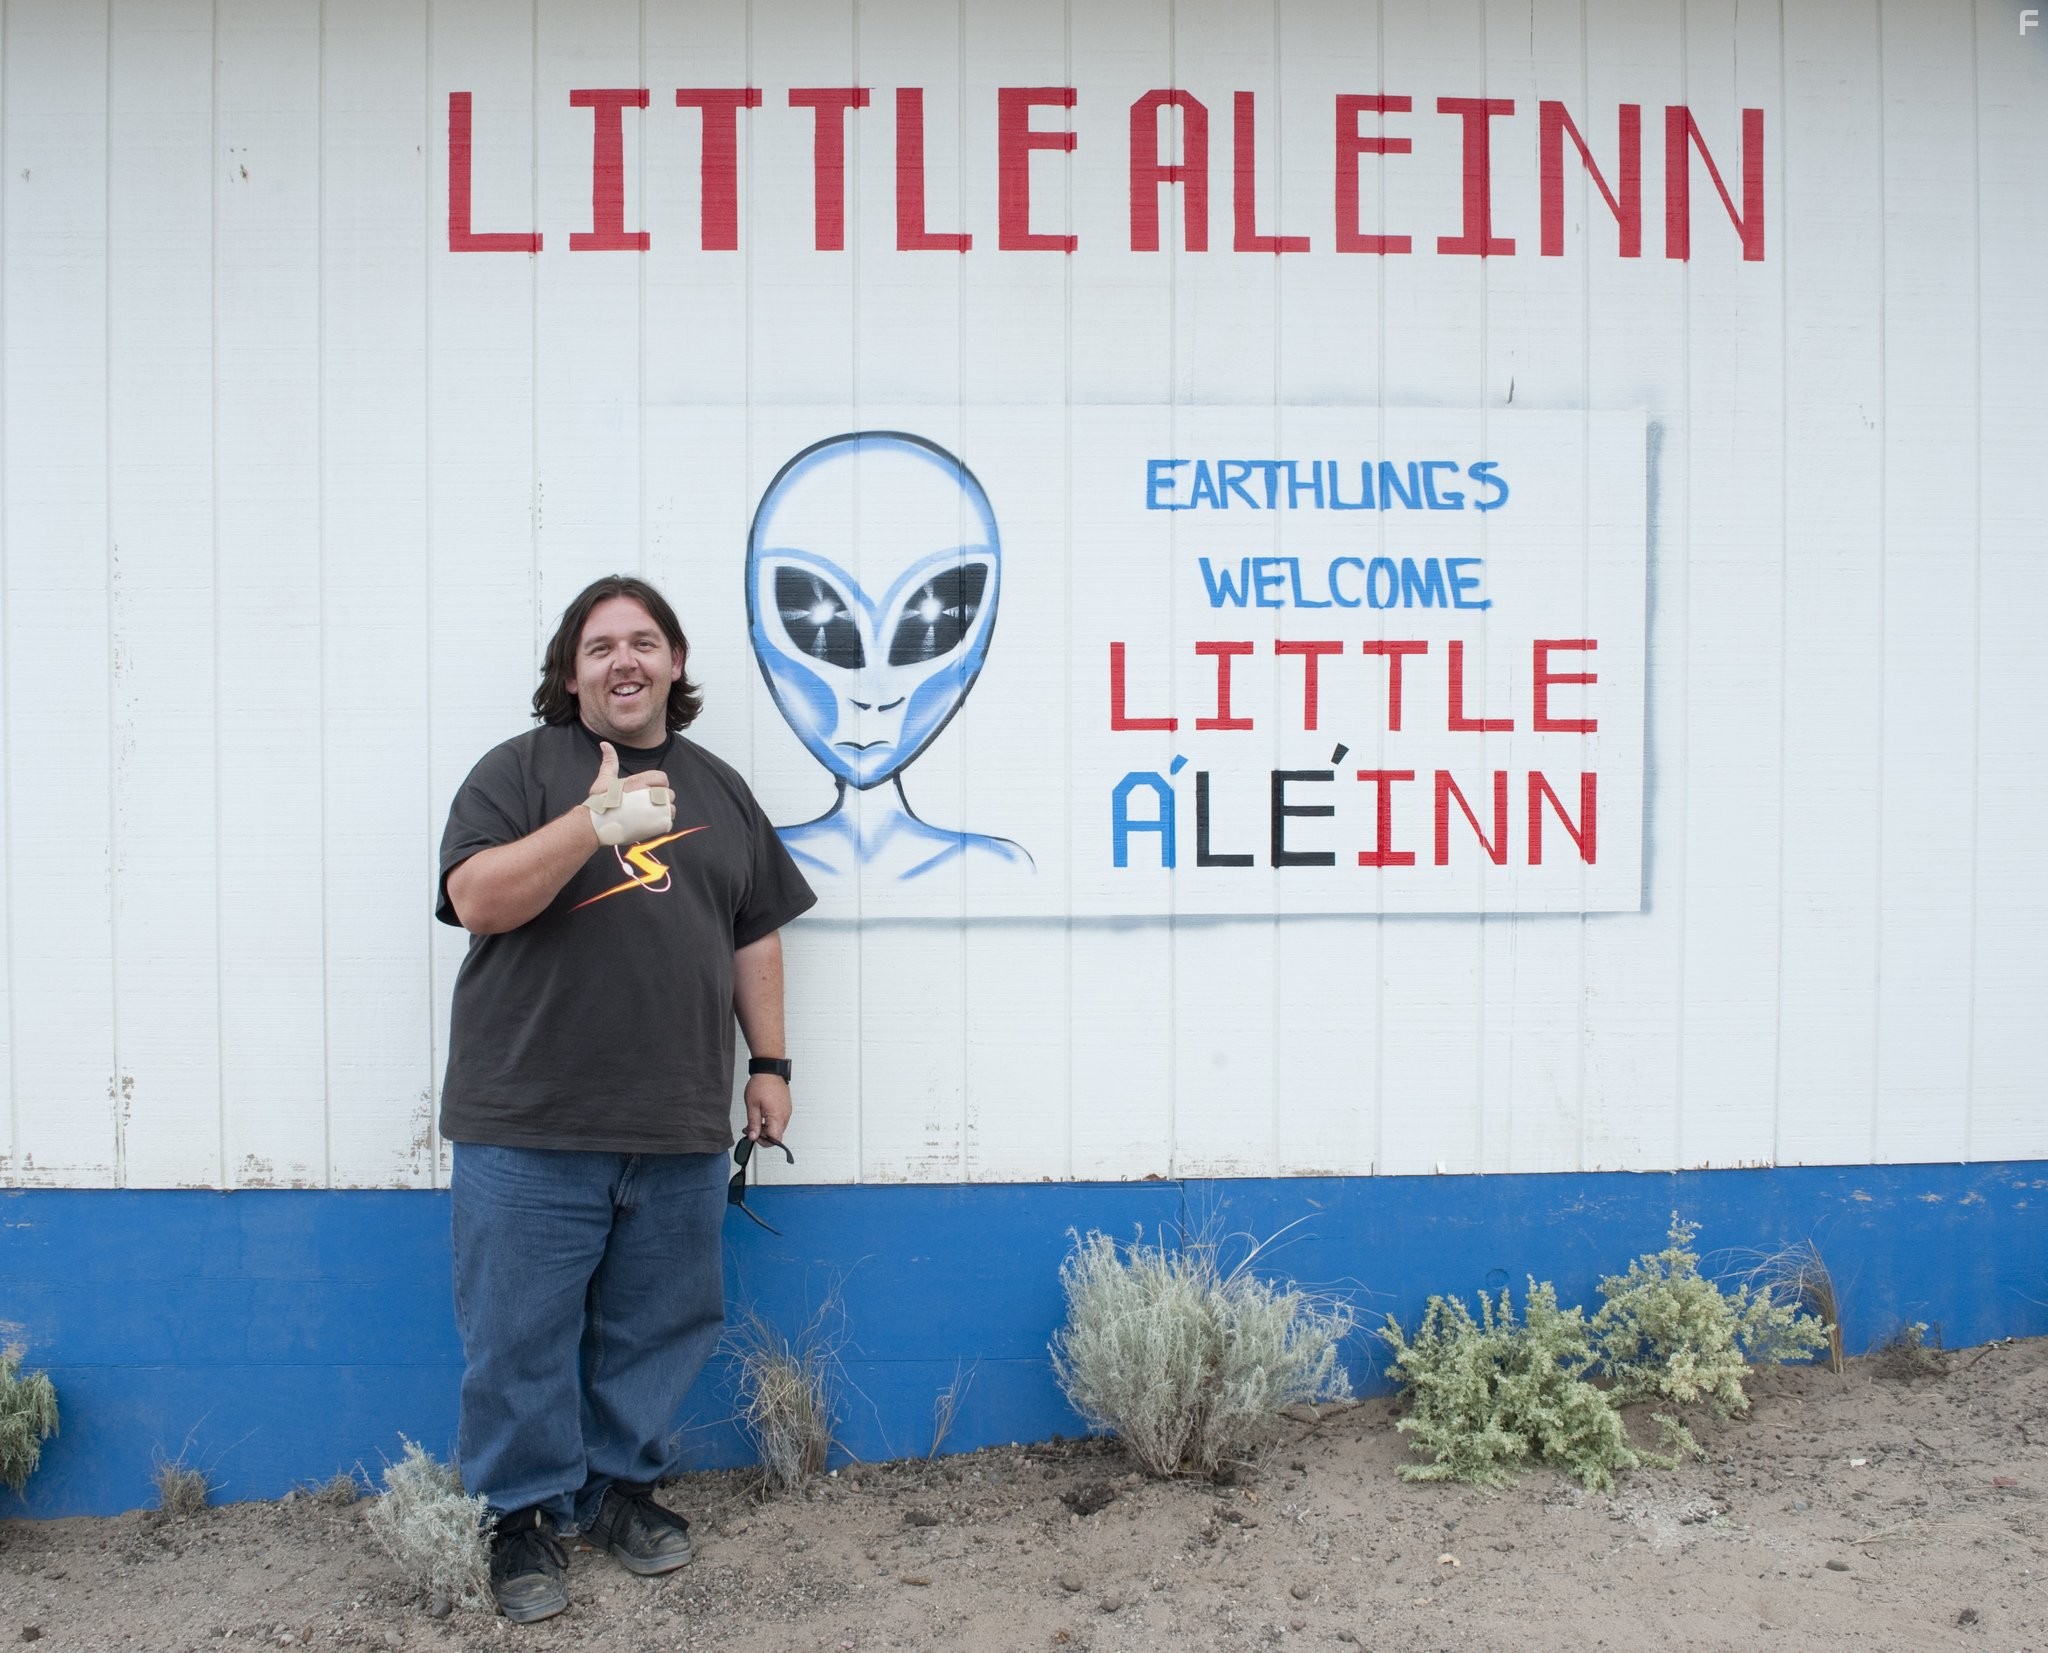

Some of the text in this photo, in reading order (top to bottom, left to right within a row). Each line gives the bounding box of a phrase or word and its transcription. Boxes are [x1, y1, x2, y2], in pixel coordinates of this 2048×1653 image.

[449, 87, 1764, 261] LITTLE ALEINN
[1146, 459, 1509, 511] EARTHLINGS
[1198, 556, 1492, 610] WELCOME
[1110, 639, 1598, 733] LITTLE
